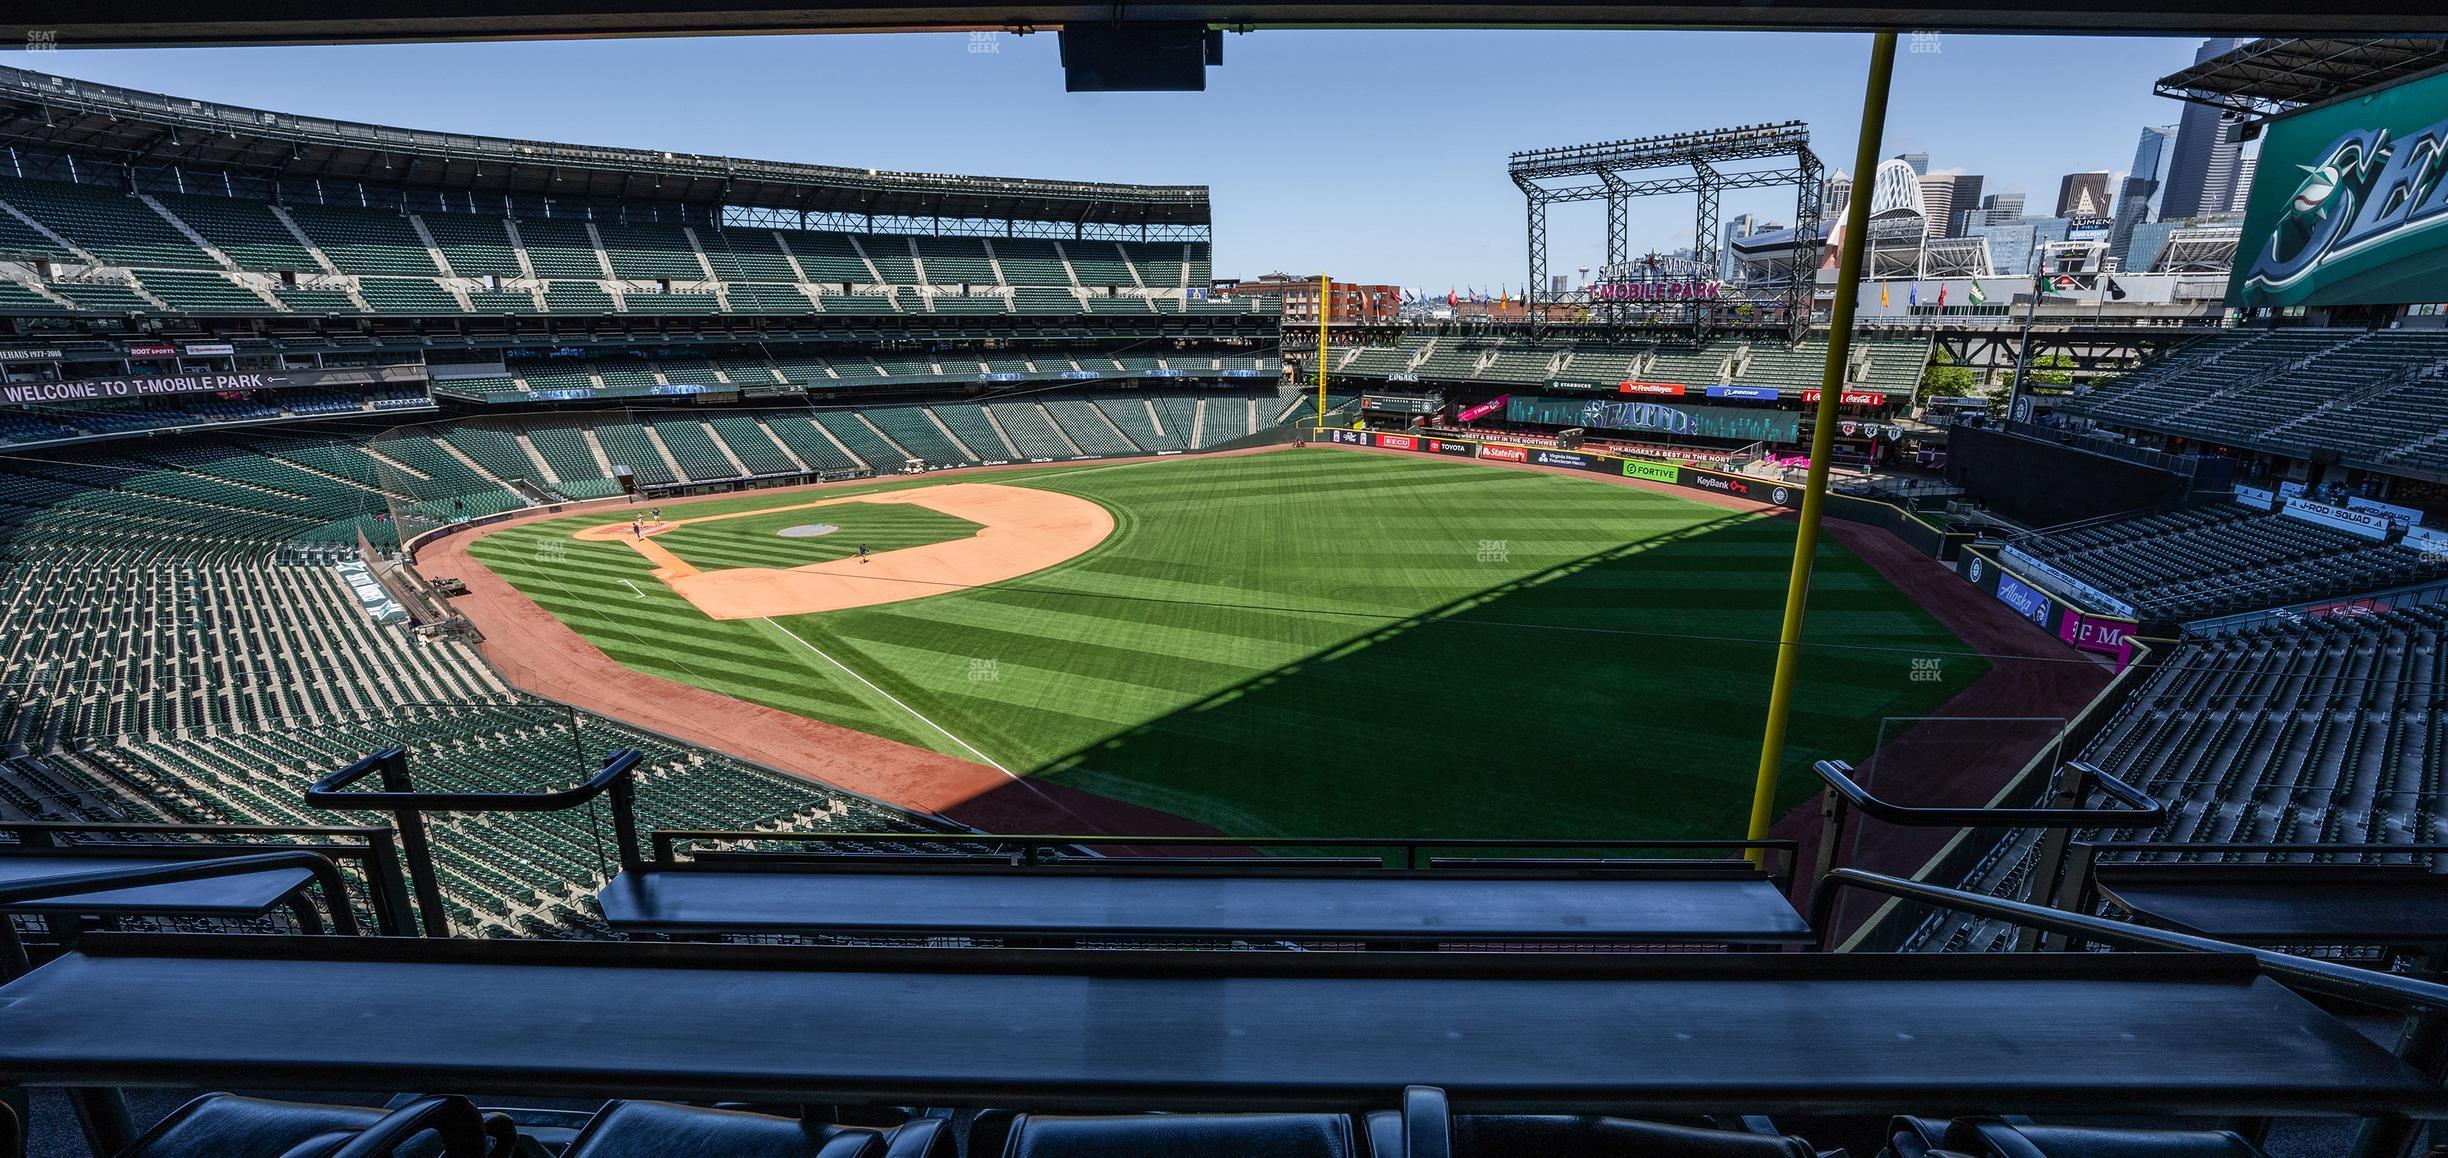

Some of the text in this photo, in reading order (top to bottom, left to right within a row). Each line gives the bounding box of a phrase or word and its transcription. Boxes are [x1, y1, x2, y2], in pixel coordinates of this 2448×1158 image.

[1670, 281, 1722, 300] PARK
[4, 374, 263, 402] WELCOME TO T-MOBILE PARK
[1441, 443, 1465, 452] TOYOTA
[1522, 437, 1557, 447] NORTHWES
[1637, 466, 1674, 478] FORTIVE
[1697, 476, 1729, 490] KeyBank
[2300, 502, 2371, 524] J-ROD SQUAD
[2000, 582, 2032, 611] Alaska
